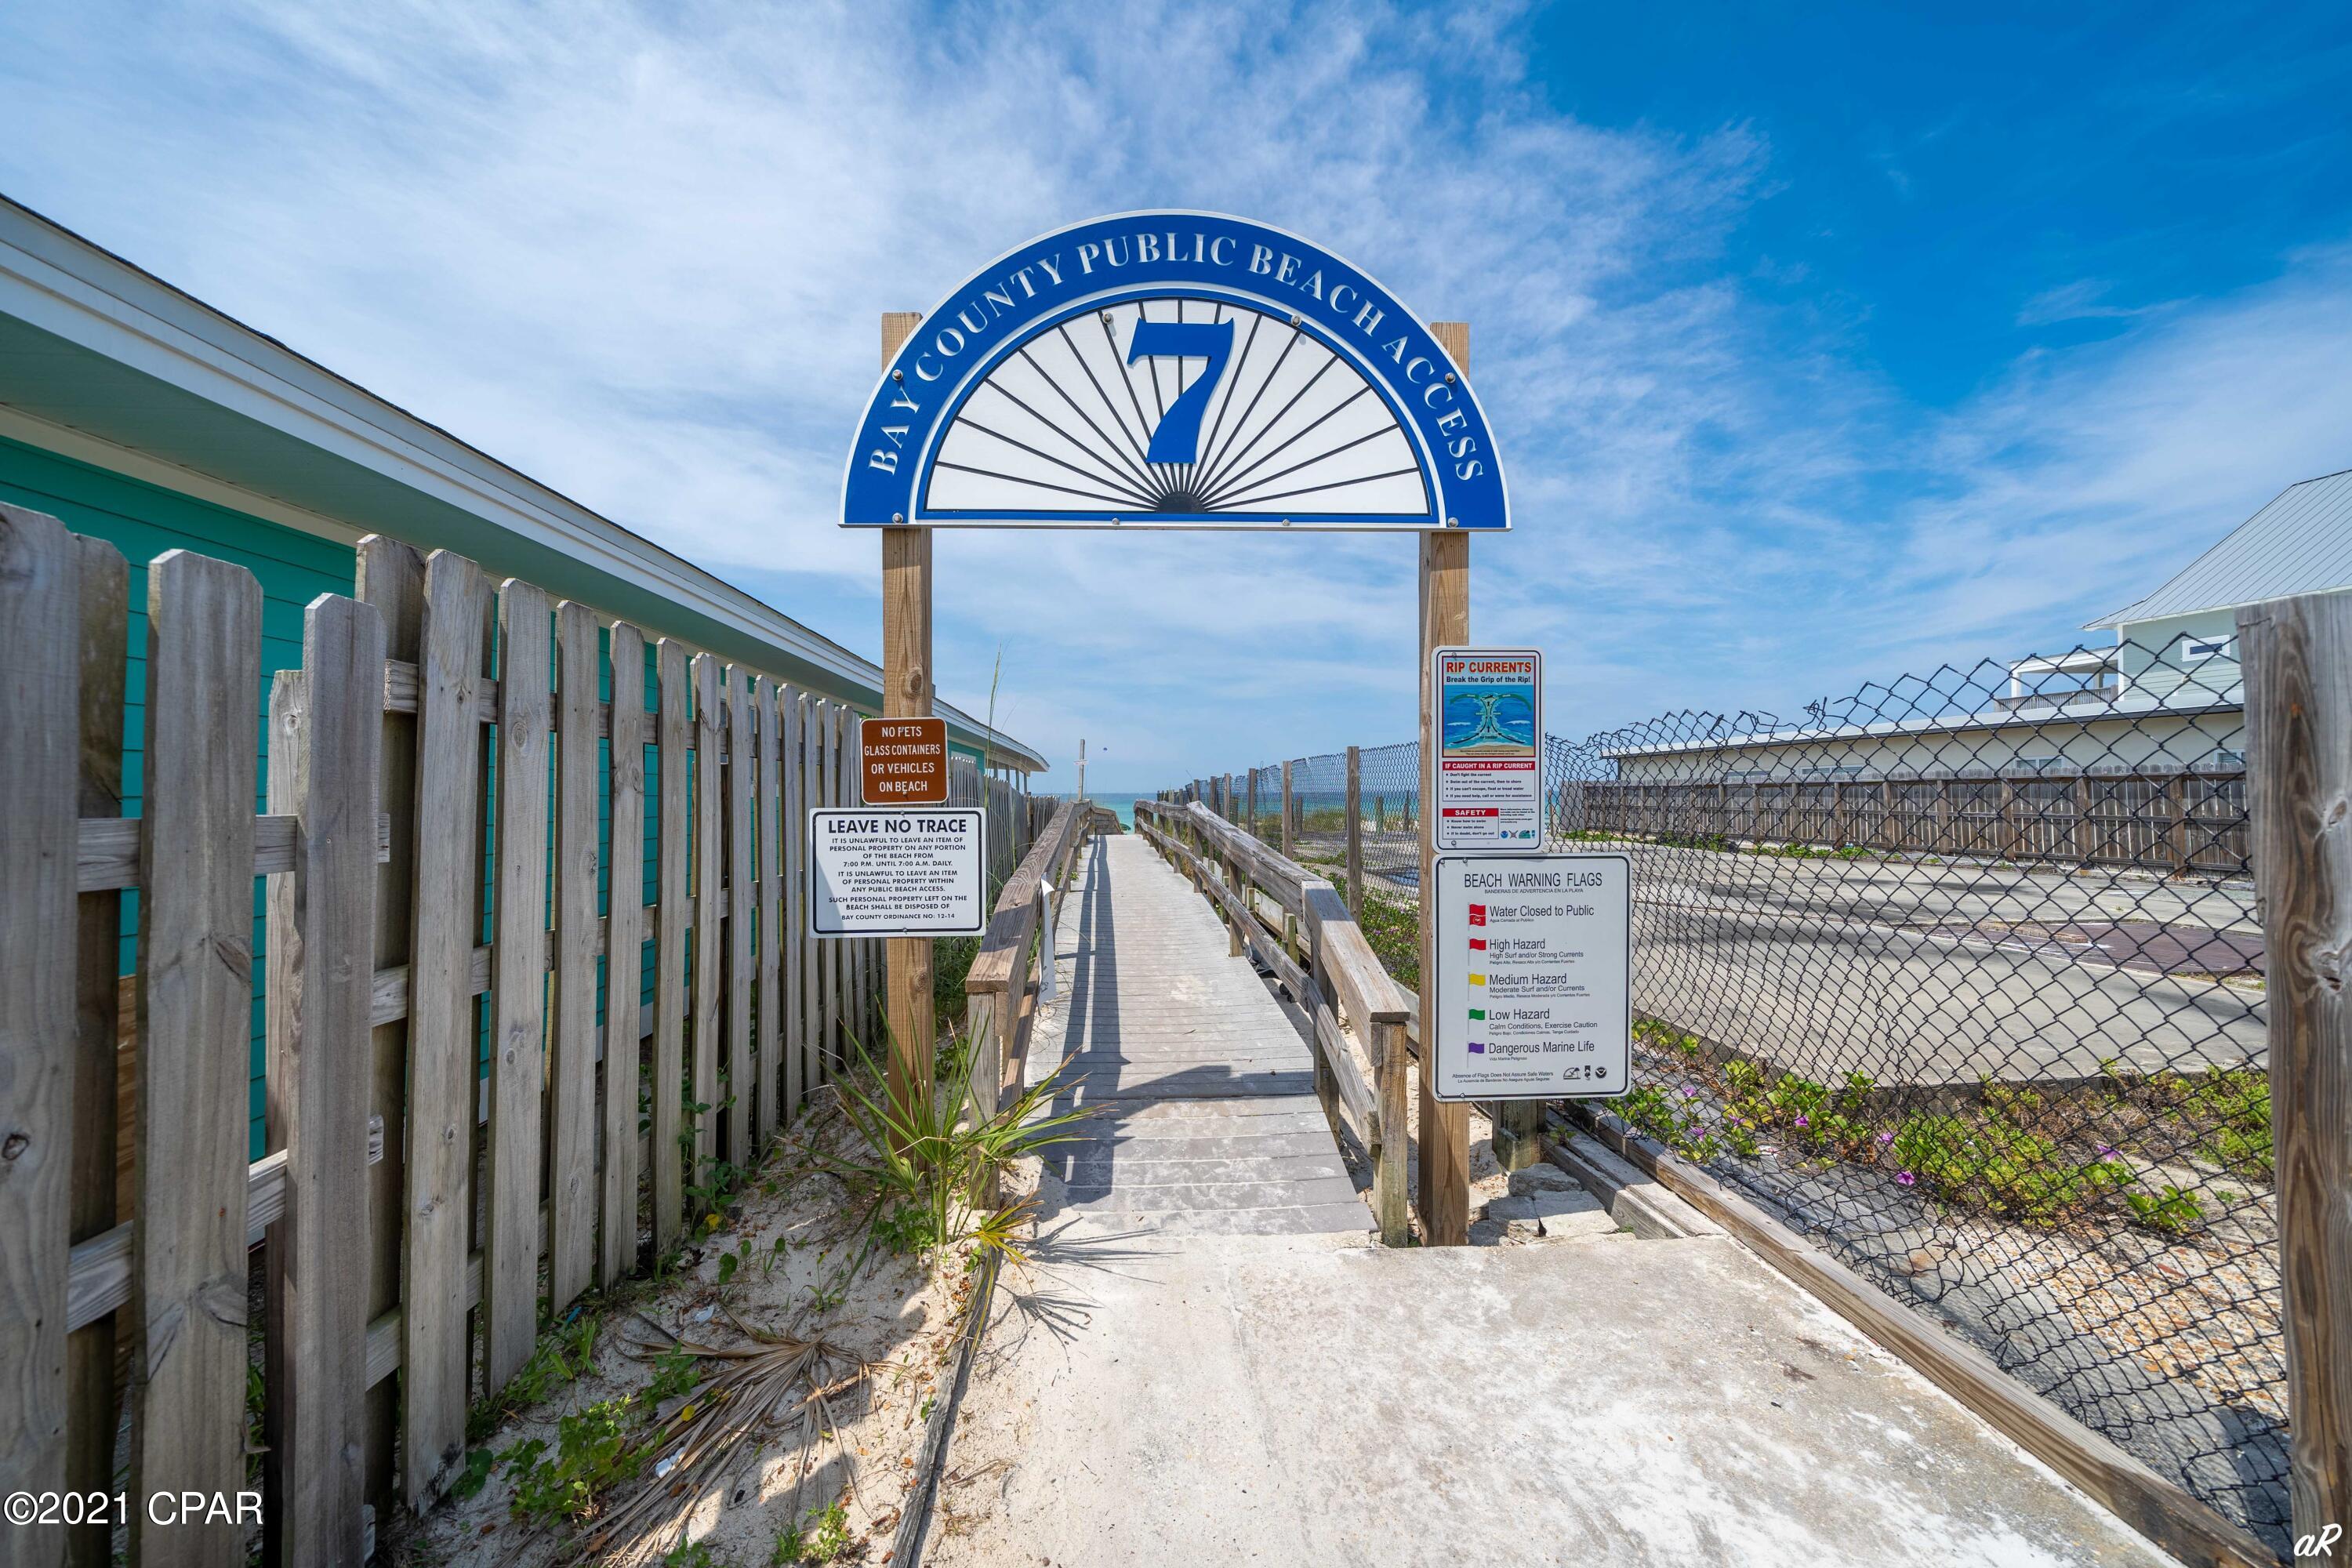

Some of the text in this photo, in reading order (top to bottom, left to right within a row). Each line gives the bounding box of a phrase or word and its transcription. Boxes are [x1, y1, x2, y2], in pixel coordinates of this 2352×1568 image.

[868, 232, 1483, 481] BAY COUNTY PUBLIC BEACH ACCESS
[1126, 317, 1235, 463] 7
[1446, 662, 1531, 673] RIP CURRENTS
[882, 727, 921, 737] NO PETS
[865, 744, 940, 756] GLASS CONTAINERS
[872, 763, 935, 774] OR VEHICLES
[880, 781, 927, 792] ON BEACH
[829, 819, 966, 833] LEAVE NO TRACE
[1465, 873, 1602, 887] BEACH WARNING FLAGS
[1490, 905, 1594, 916] Water Closed to Public
[1490, 938, 1545, 952] High Hazard
[1490, 974, 1566, 985] Medium Hazard
[1490, 1008, 1549, 1020] Low Hazard
[1490, 1041, 1595, 1055] Dangerous Marine Life
